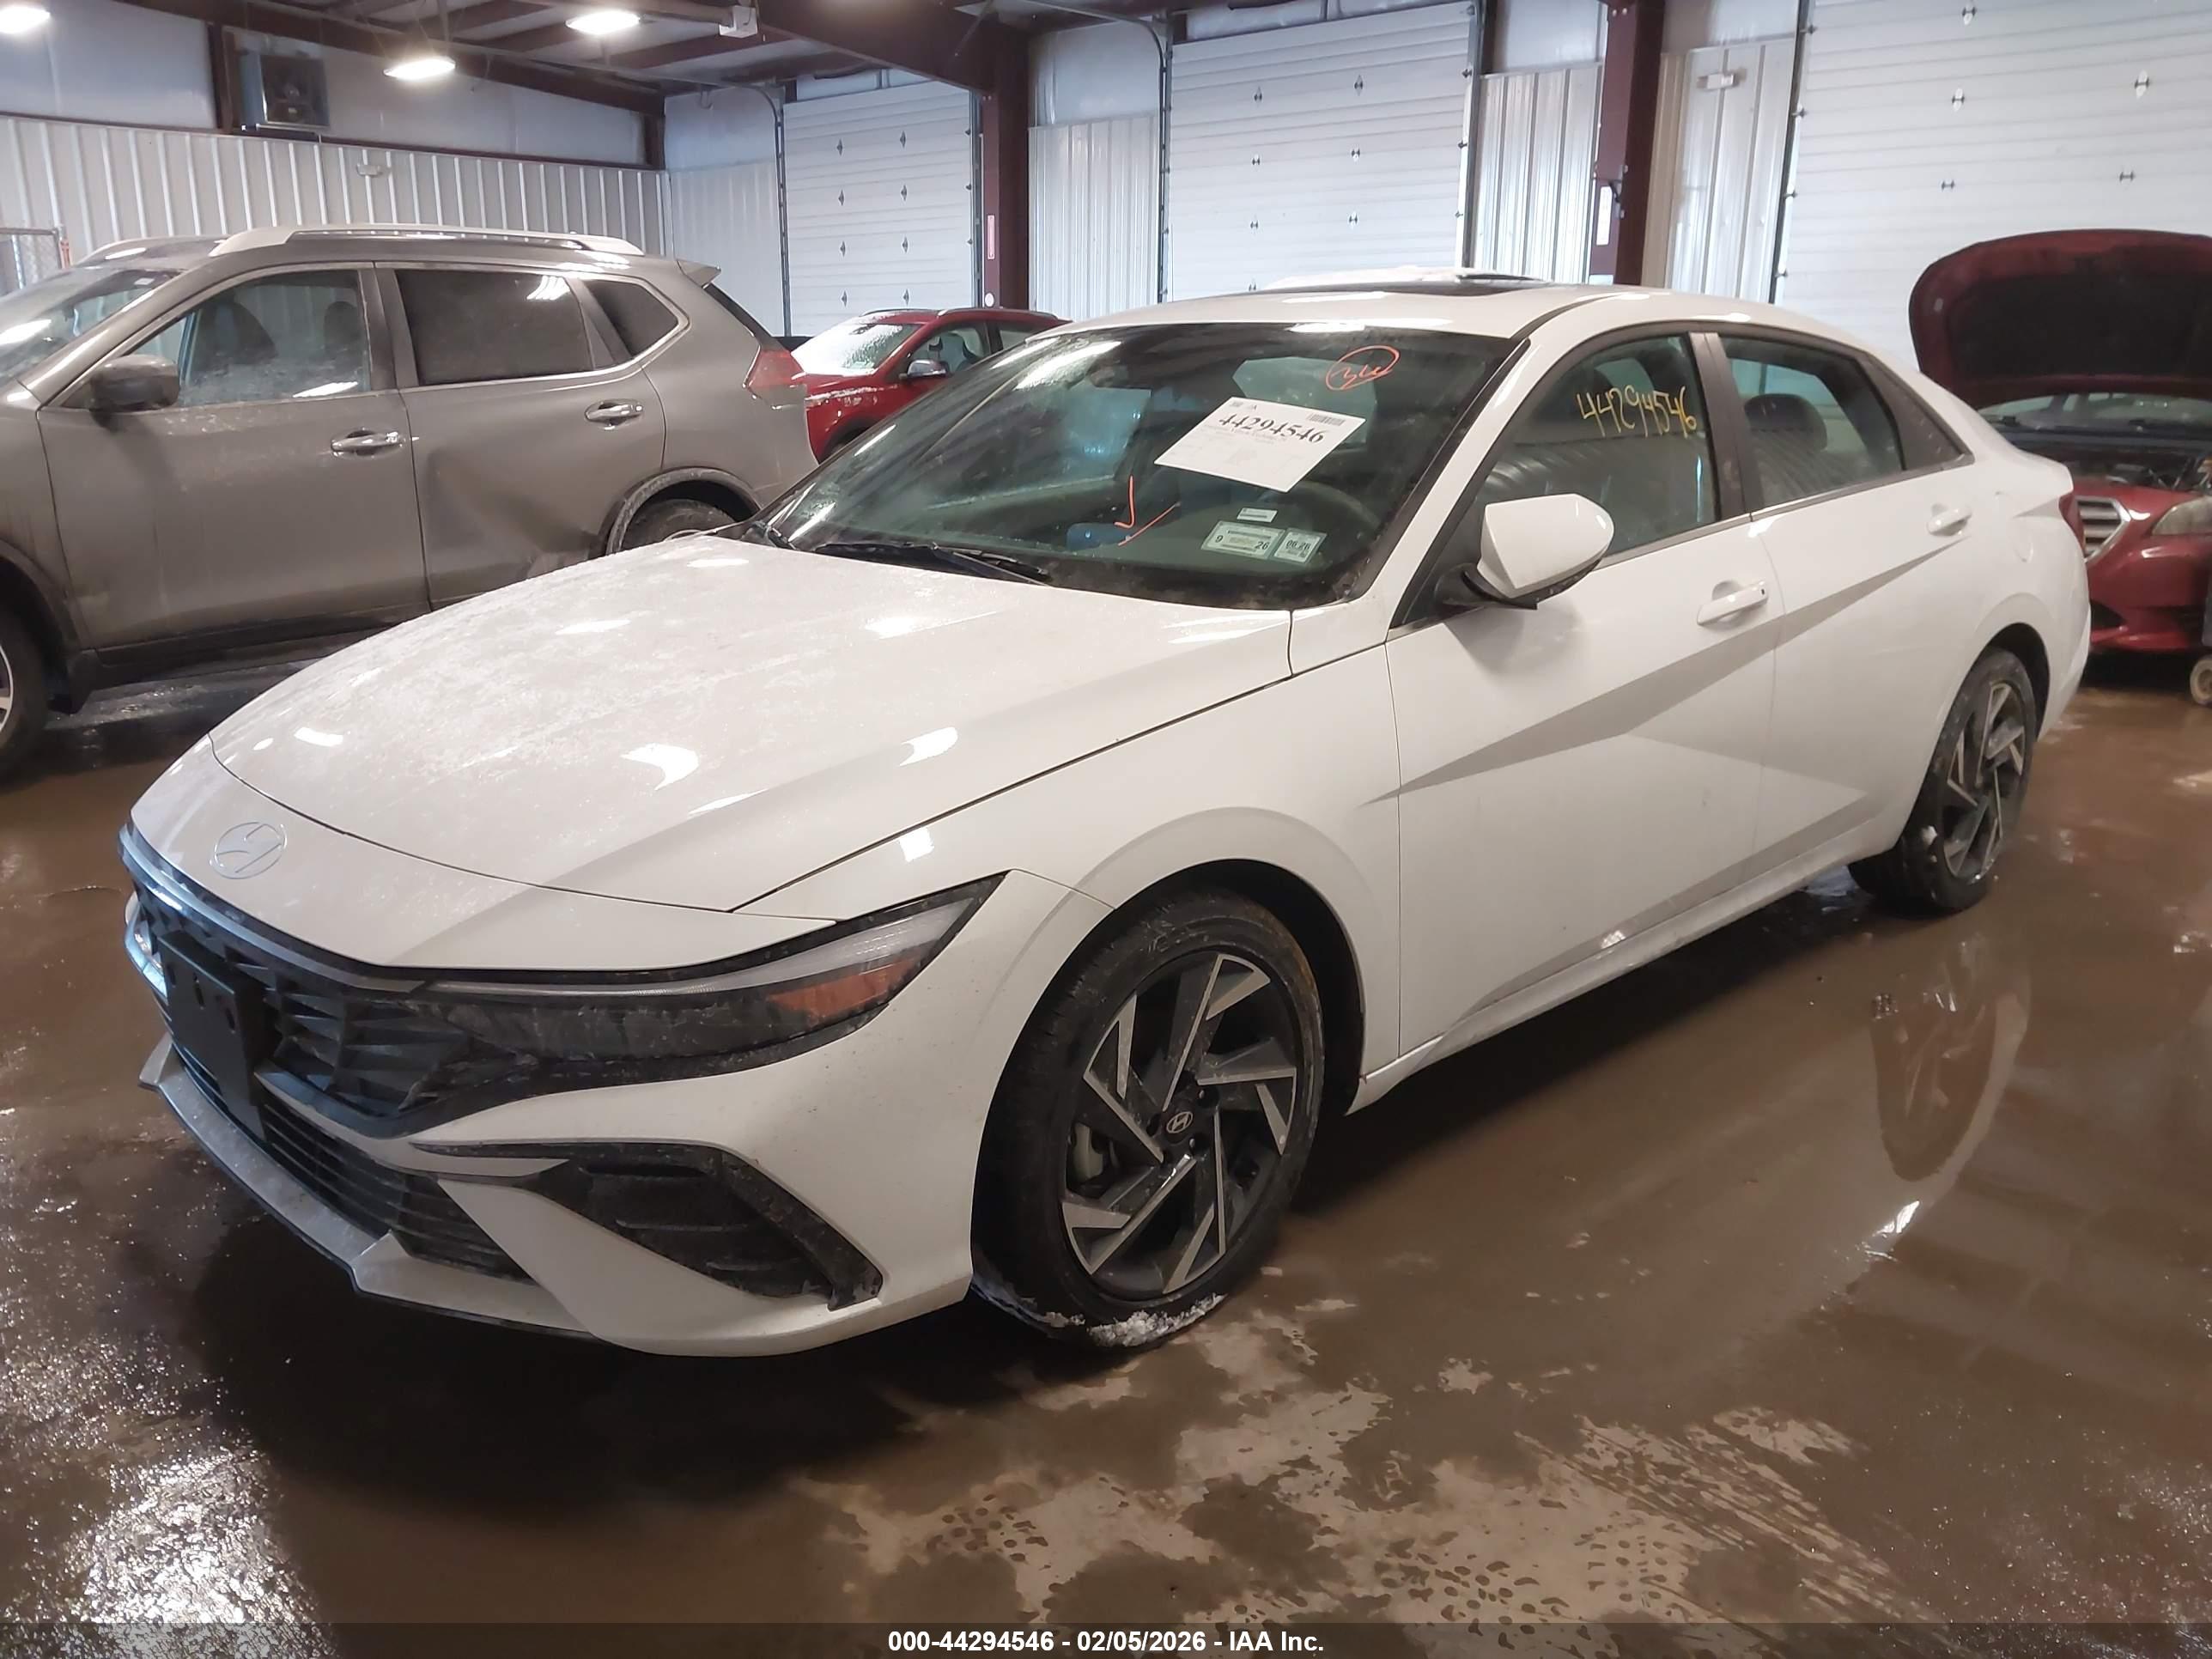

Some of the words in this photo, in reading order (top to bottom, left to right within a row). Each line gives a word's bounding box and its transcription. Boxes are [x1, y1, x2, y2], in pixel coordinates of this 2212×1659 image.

[1576, 384, 1698, 439] 44294546
[1218, 413, 1325, 443] 44294546
[1255, 541, 1269, 550] 26
